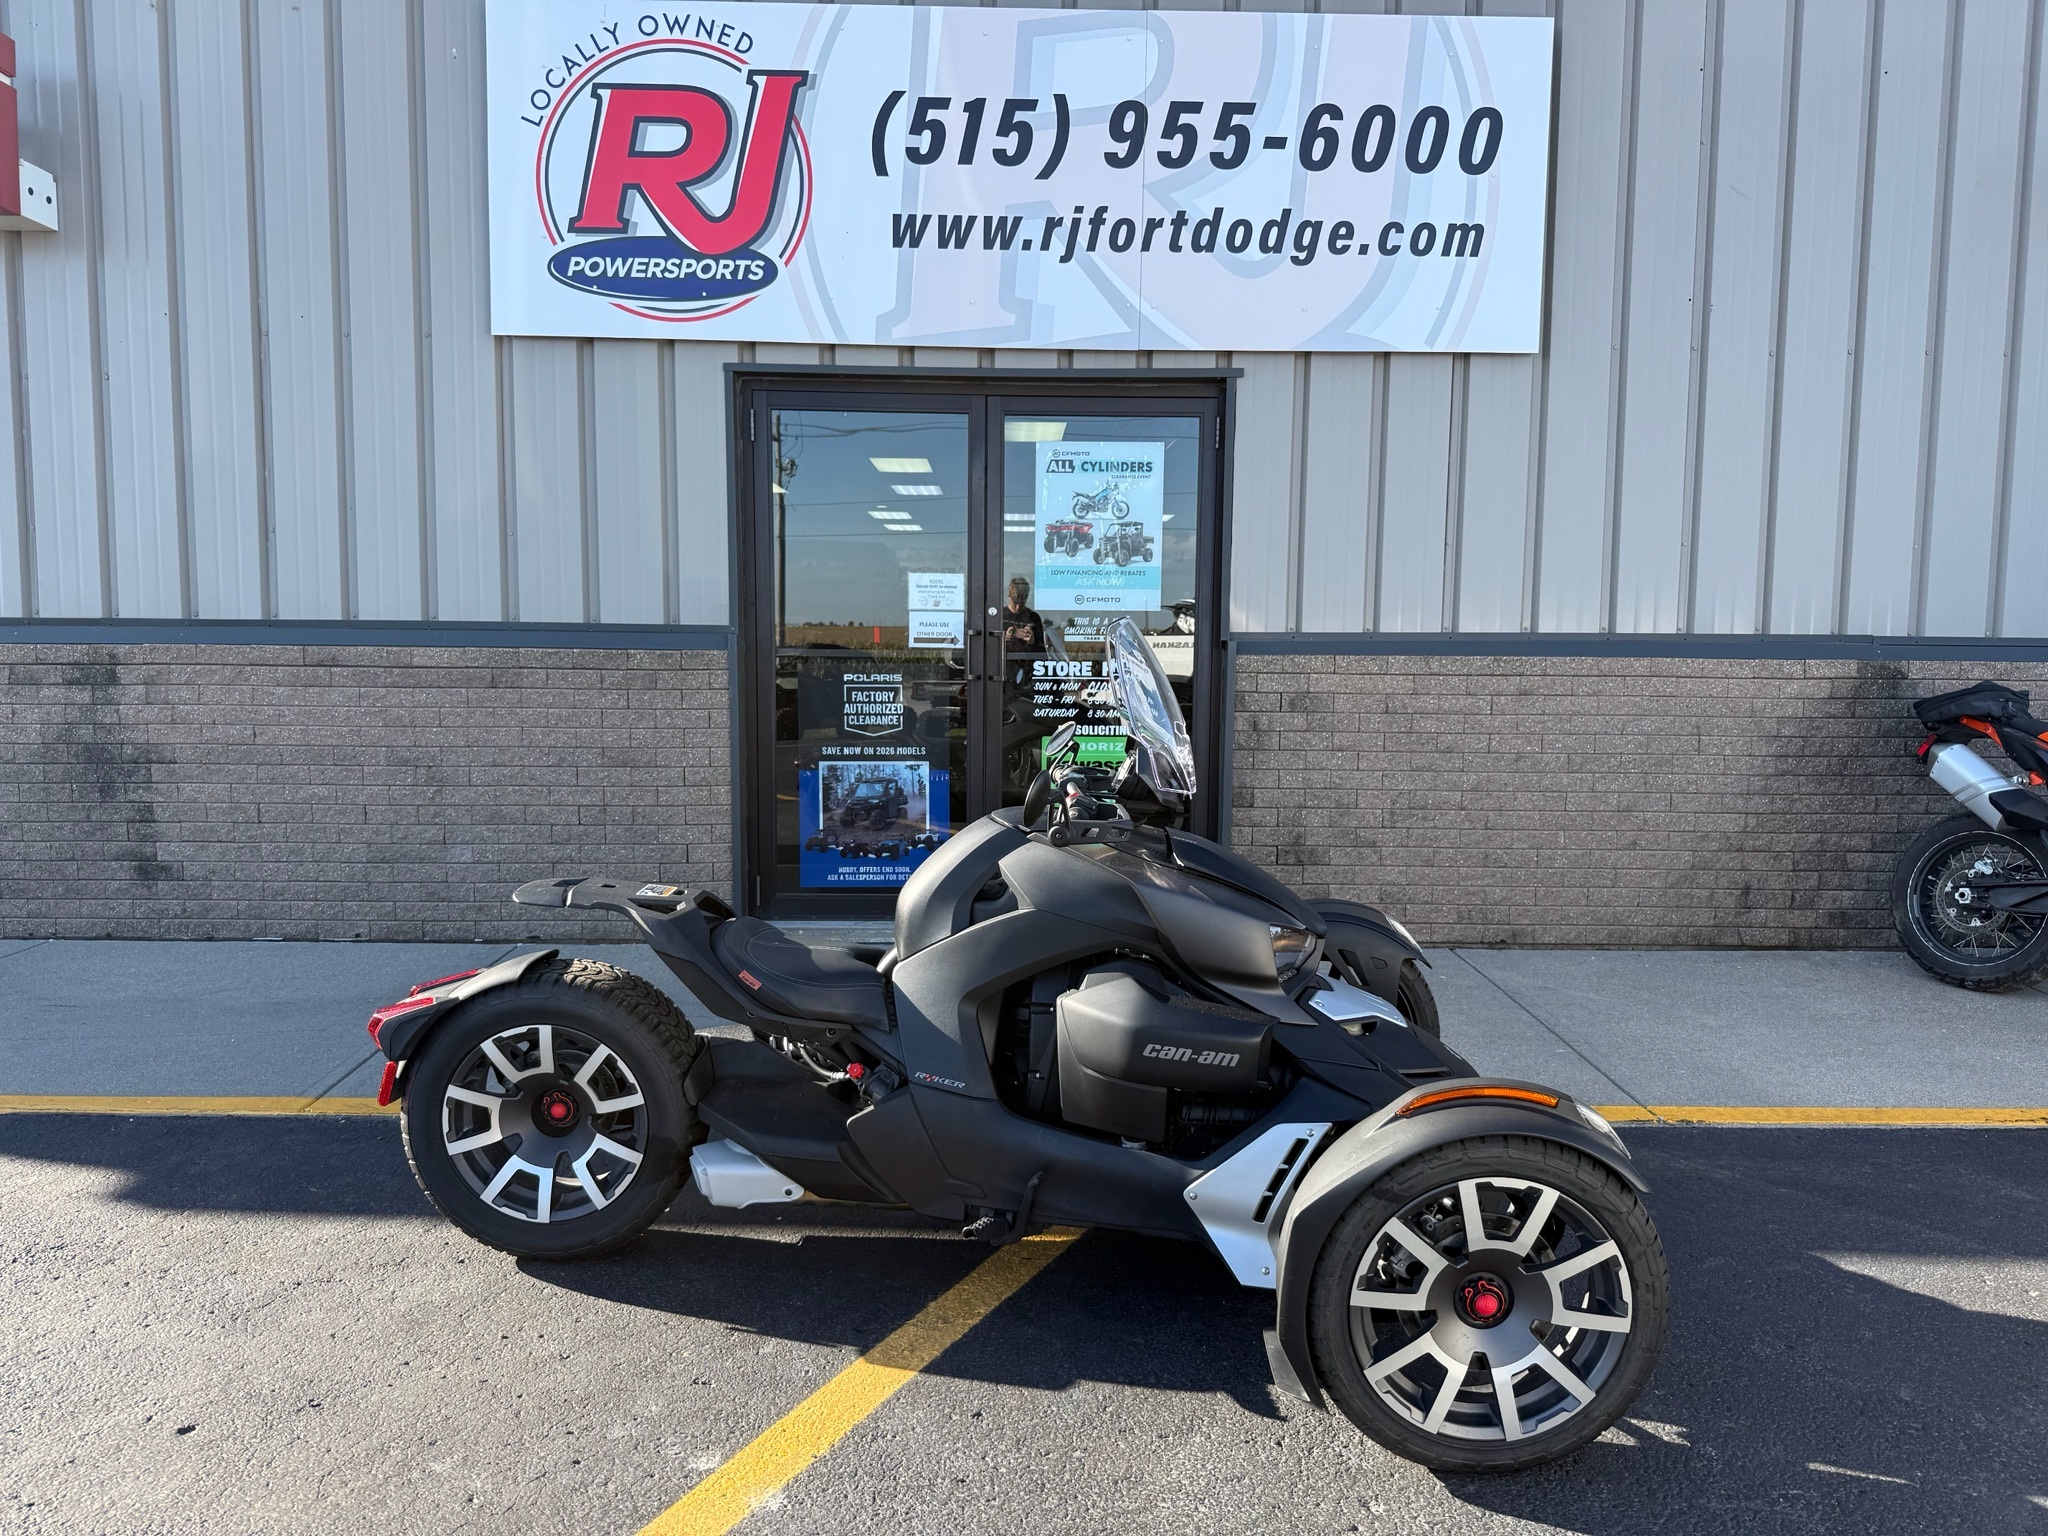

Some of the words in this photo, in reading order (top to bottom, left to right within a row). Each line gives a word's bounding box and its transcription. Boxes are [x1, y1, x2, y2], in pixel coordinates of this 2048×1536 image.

[520, 24, 622, 128] LOCALLY
[637, 12, 754, 55] OWNED
[871, 90, 1071, 180] (515)
[1103, 99, 1503, 176] 955-6000
[567, 69, 812, 256] RJ
[891, 204, 1485, 267] www.rjfortdodge.com
[566, 255, 766, 282] POWERSPORTS
[1047, 460, 1074, 473] ALL
[1080, 461, 1153, 473] CYLINDERS
[1075, 577, 1095, 586] ASK
[1073, 616, 1090, 625] THIS
[1092, 617, 1101, 625] IS
[1103, 617, 1109, 626] A
[1064, 626, 1097, 635] SMOKING
[1032, 660, 1092, 677] STORE
[843, 673, 903, 682] POLARIS
[1033, 681, 1053, 691] SUN
[1052, 683, 1058, 691] &
[1058, 682, 1081, 691] MON
[851, 691, 895, 702] FACTORY
[1033, 694, 1054, 704] TUES
[1060, 695, 1076, 704] FRI
[843, 703, 904, 714] AUTHORIZED
[1033, 708, 1080, 718] SATURDAY
[848, 715, 899, 725] CLEARANCE
[1075, 724, 1127, 736] SOLICITIN
[821, 746, 841, 755] SAVE
[843, 746, 862, 755] NOW
[863, 747, 874, 755] ON
[876, 747, 895, 755] 2026
[896, 747, 927, 755] MODELS
[838, 866, 859, 874] HURRY,
[1142, 1043, 1241, 1068] can-am
[914, 1071, 966, 1089] RYKER
